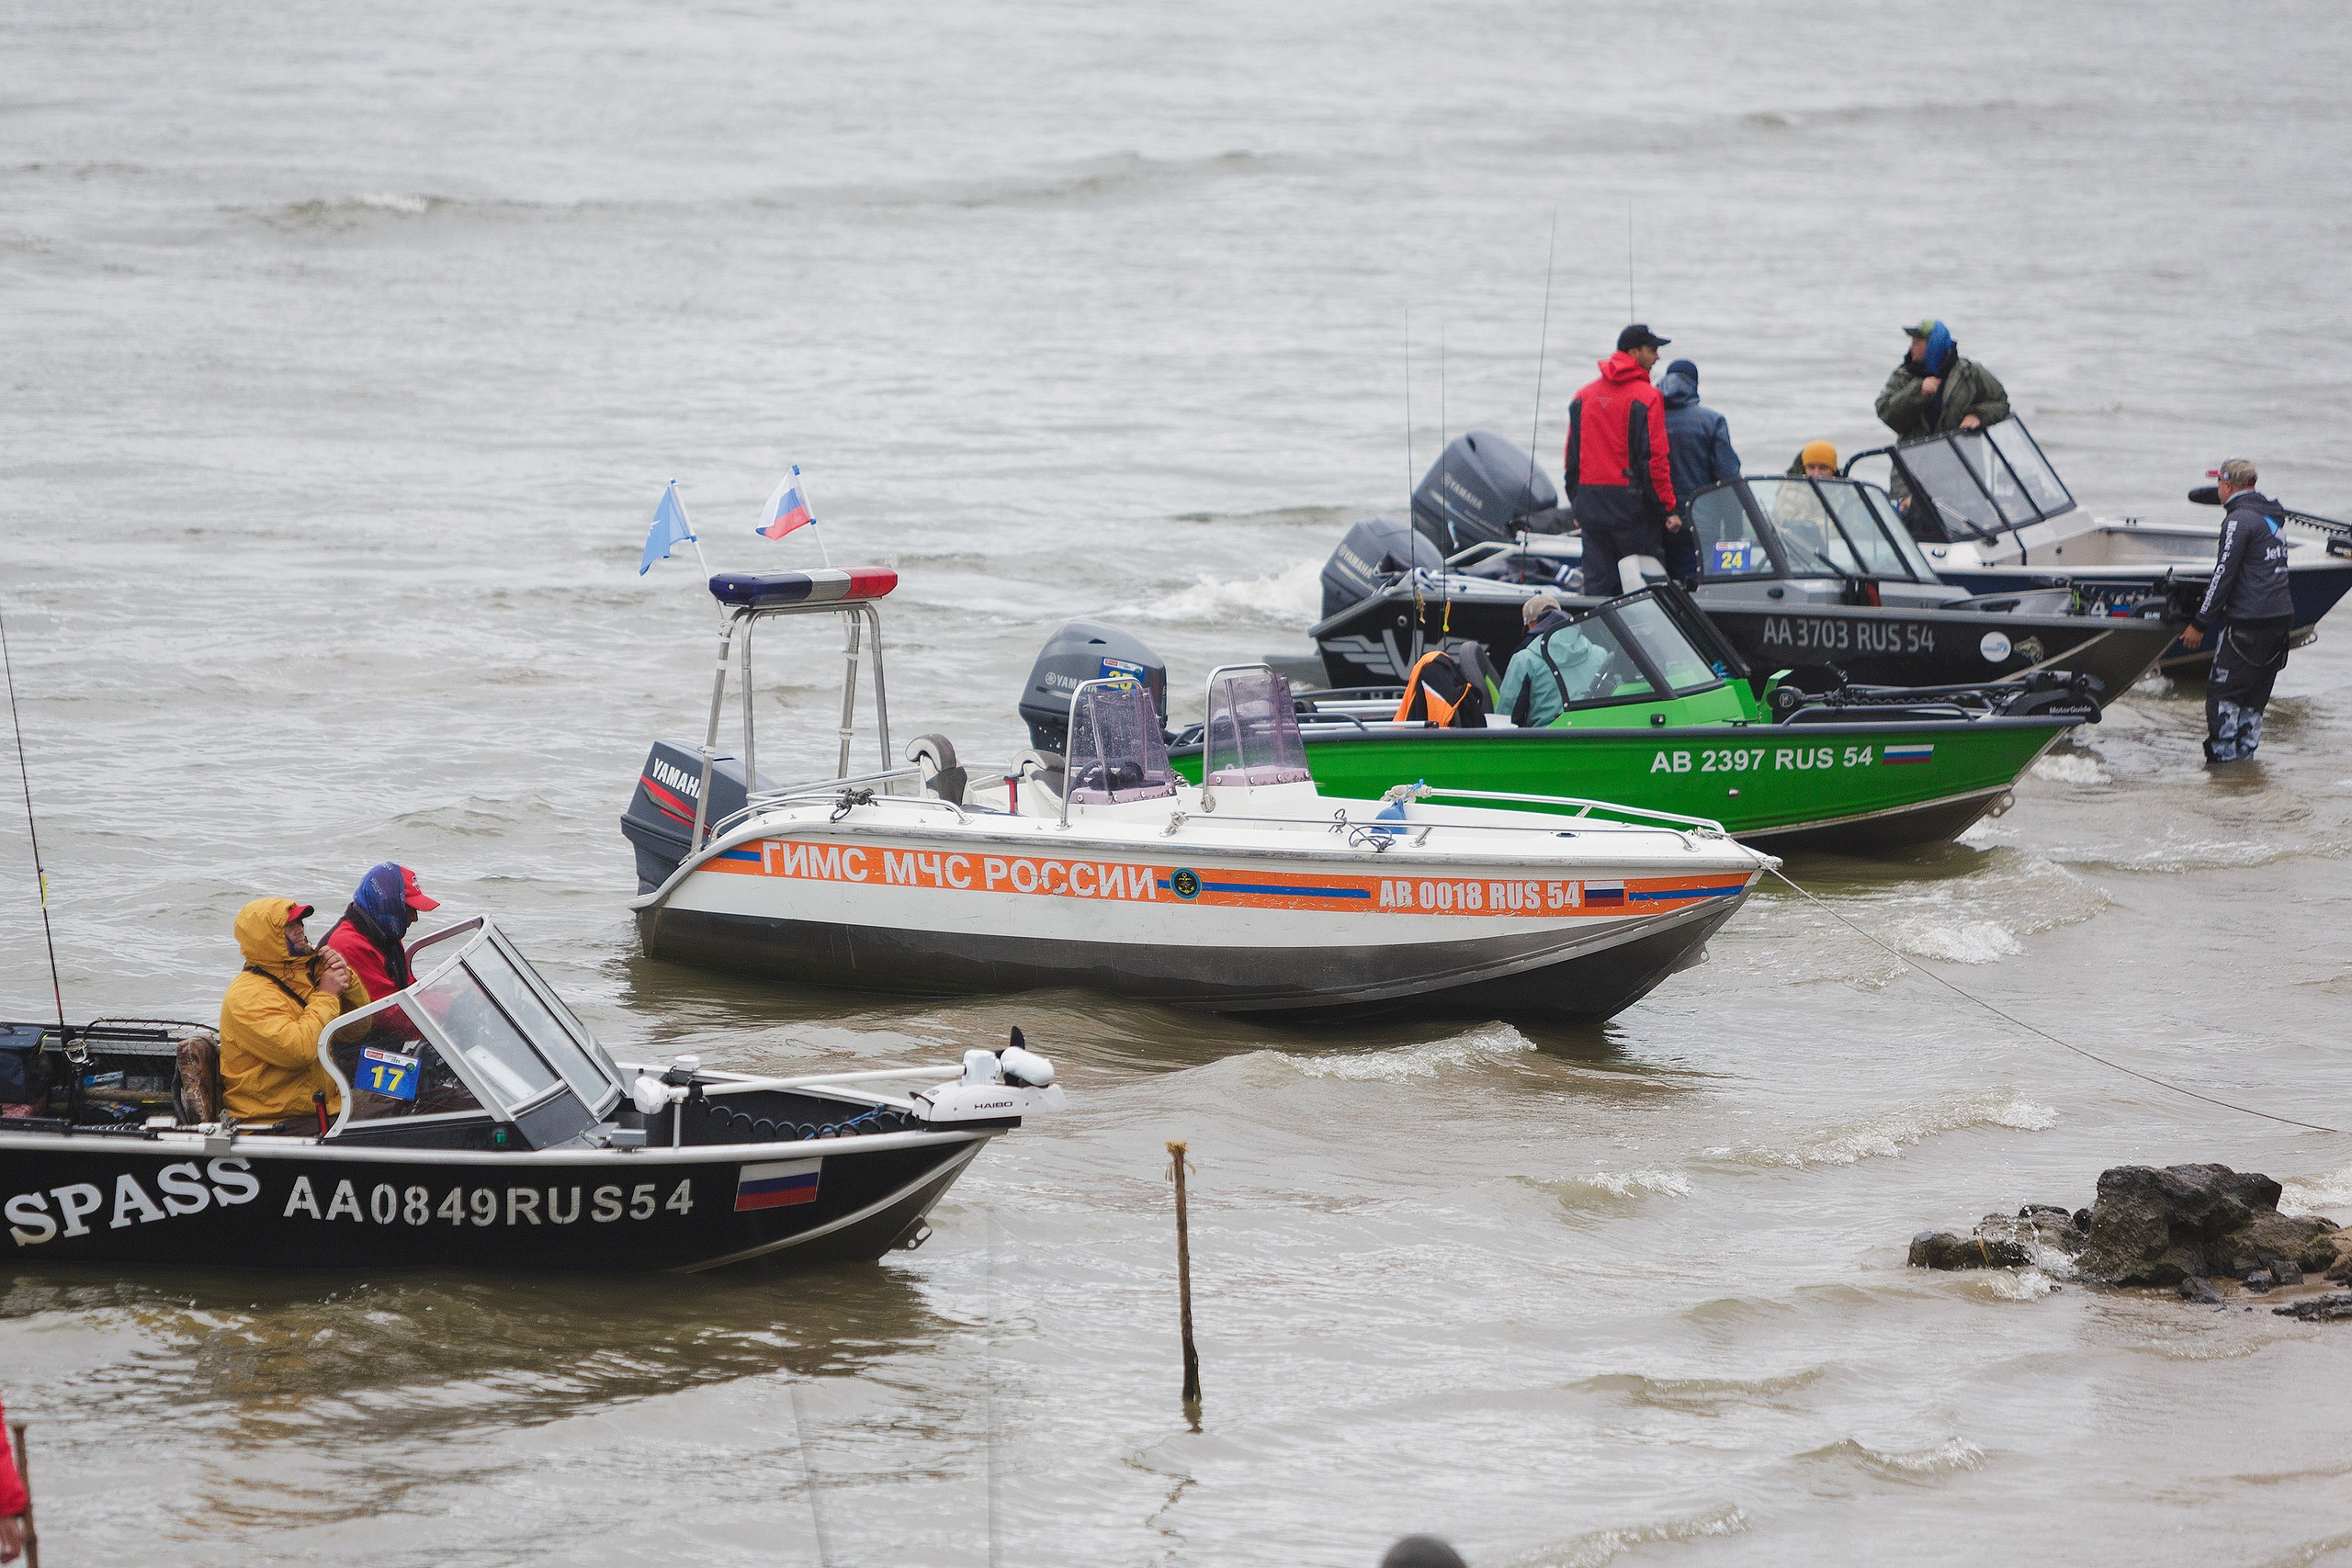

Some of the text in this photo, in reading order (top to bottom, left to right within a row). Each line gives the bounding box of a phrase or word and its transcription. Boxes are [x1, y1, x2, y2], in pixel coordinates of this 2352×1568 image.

[1721, 551, 1743, 570] 24
[1762, 616, 1935, 653] AA 3703 RUS 54
[1107, 671, 1134, 691] 25
[1650, 746, 1873, 773] AB 2397 RUS 54
[652, 758, 701, 799] YAMAH
[763, 841, 1158, 900] ГИМС МЧС РОССИИ
[1419, 881, 1483, 909] 0018
[1489, 881, 1541, 910] RUS
[1547, 881, 1582, 909] 54
[371, 1066, 404, 1092] 17
[974, 1101, 1013, 1110] HAIBO
[4, 1157, 260, 1247] SPASS
